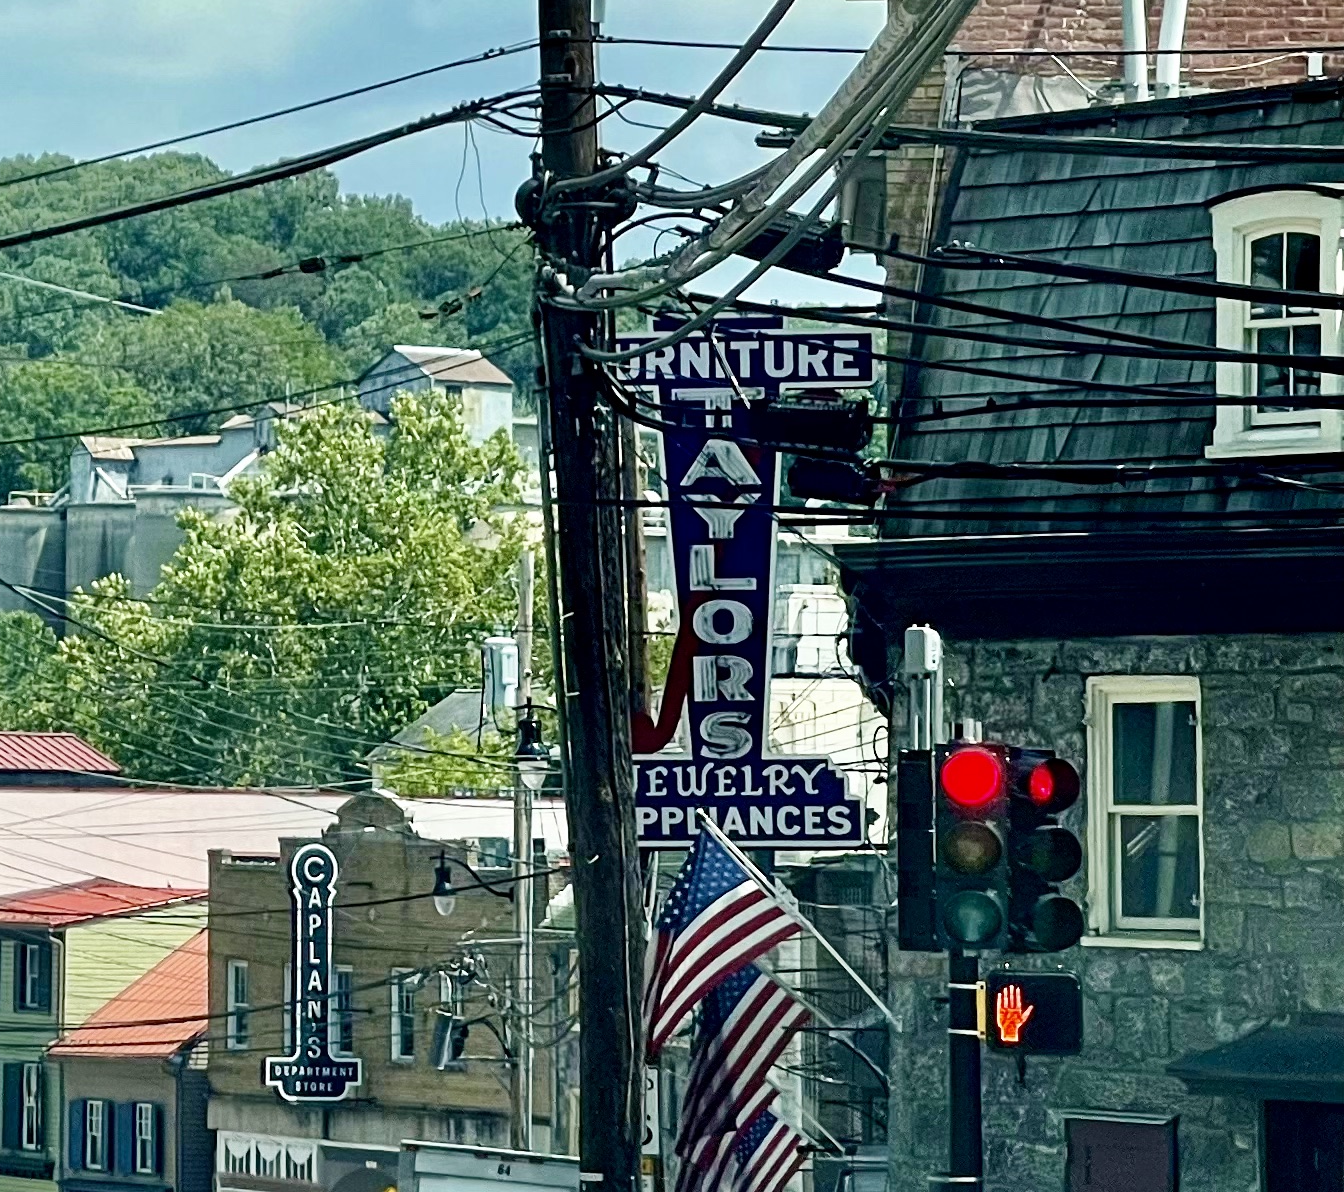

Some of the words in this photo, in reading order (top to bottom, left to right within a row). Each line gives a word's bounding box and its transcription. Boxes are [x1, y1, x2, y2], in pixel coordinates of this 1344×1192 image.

[616, 340, 860, 380] URNITURE
[672, 387, 765, 759] TAYLORS
[638, 805, 853, 836] PPLIANCES
[304, 856, 325, 1058] CAPLAN'S
[274, 1064, 354, 1078] DEPARTMENT
[295, 1080, 333, 1092] STORE
